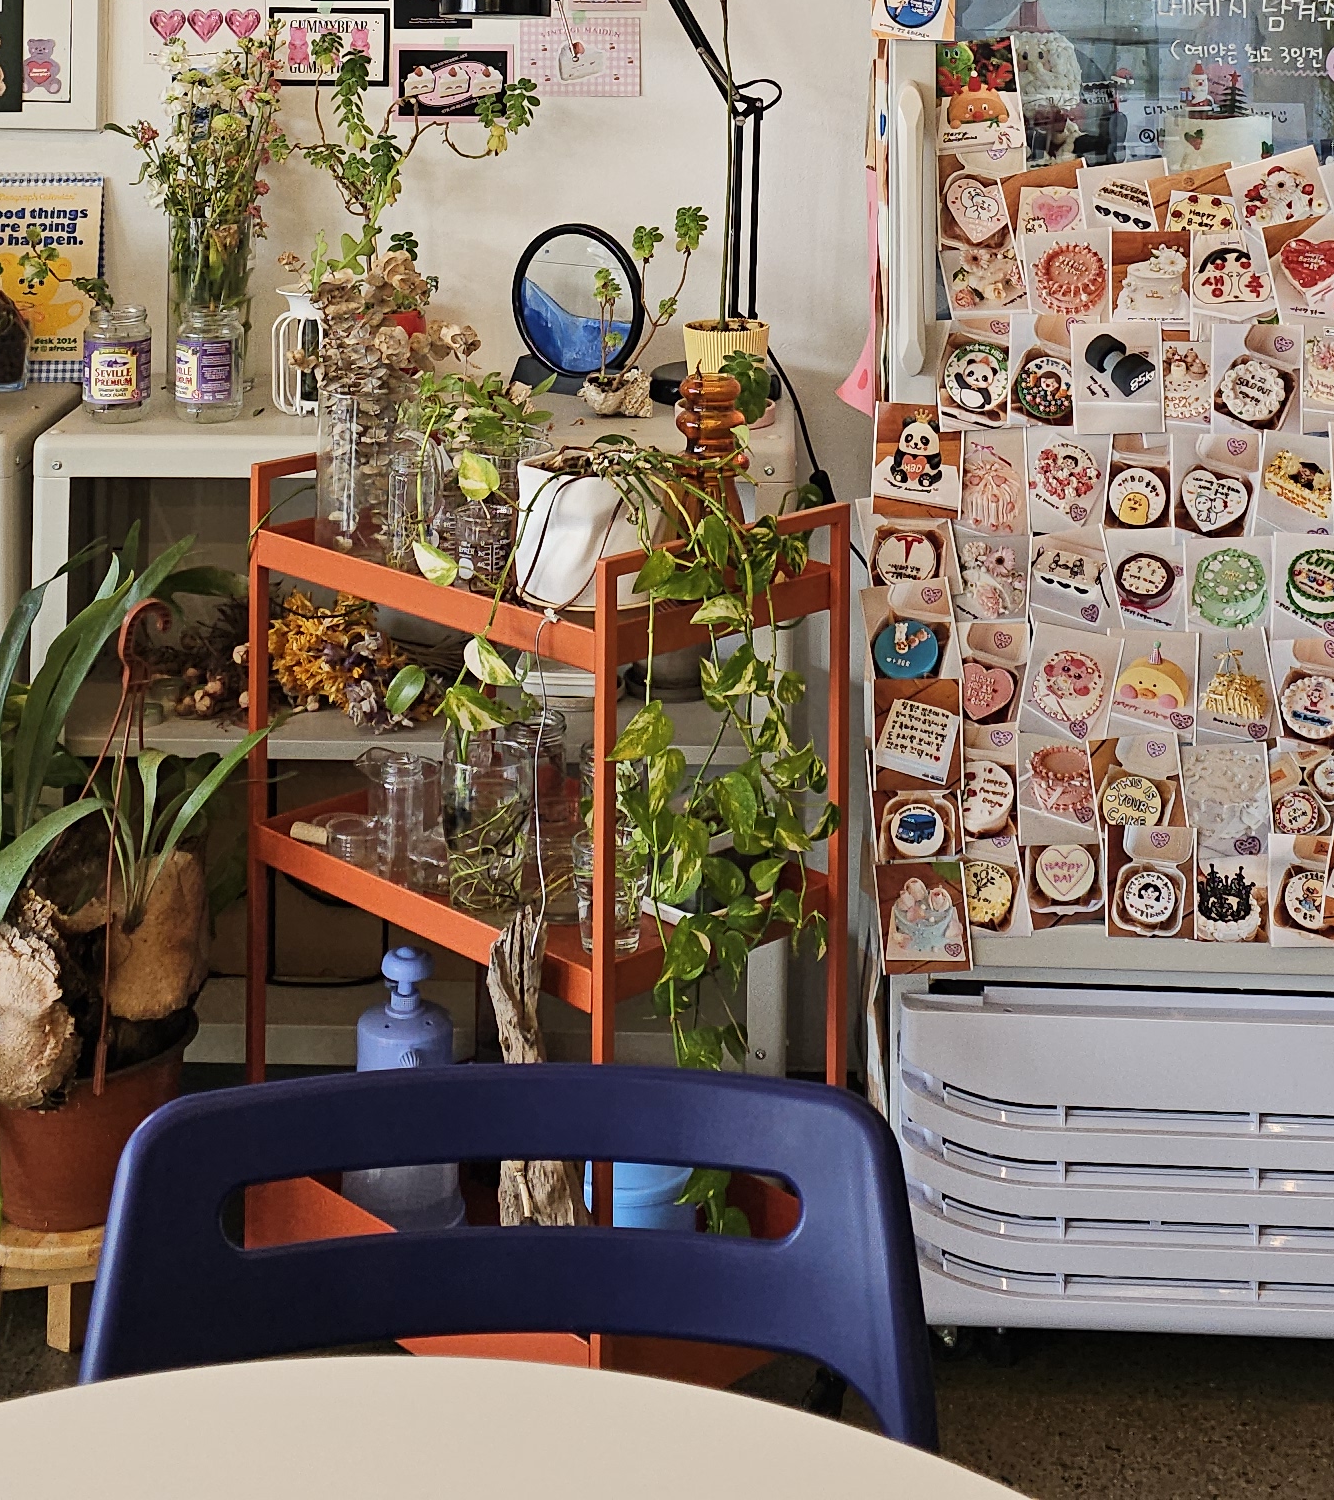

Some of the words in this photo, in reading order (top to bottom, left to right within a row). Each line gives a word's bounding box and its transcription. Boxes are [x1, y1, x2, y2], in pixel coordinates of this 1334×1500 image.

[584, 26, 623, 39] MAIDEN
[1279, 45, 1324, 68] 3일전
[29, 207, 89, 221] things
[94, 367, 133, 378] SEVILLE
[94, 377, 133, 388] PREMIUM
[1235, 376, 1257, 390] SOLD
[1256, 385, 1273, 397] OUT
[1110, 777, 1143, 793] THIS
[1142, 785, 1157, 802] IS
[1118, 792, 1150, 814] YOUR
[1106, 806, 1147, 826] CAKE
[1044, 860, 1084, 874] HAPPY
[1052, 873, 1075, 884] DAY
